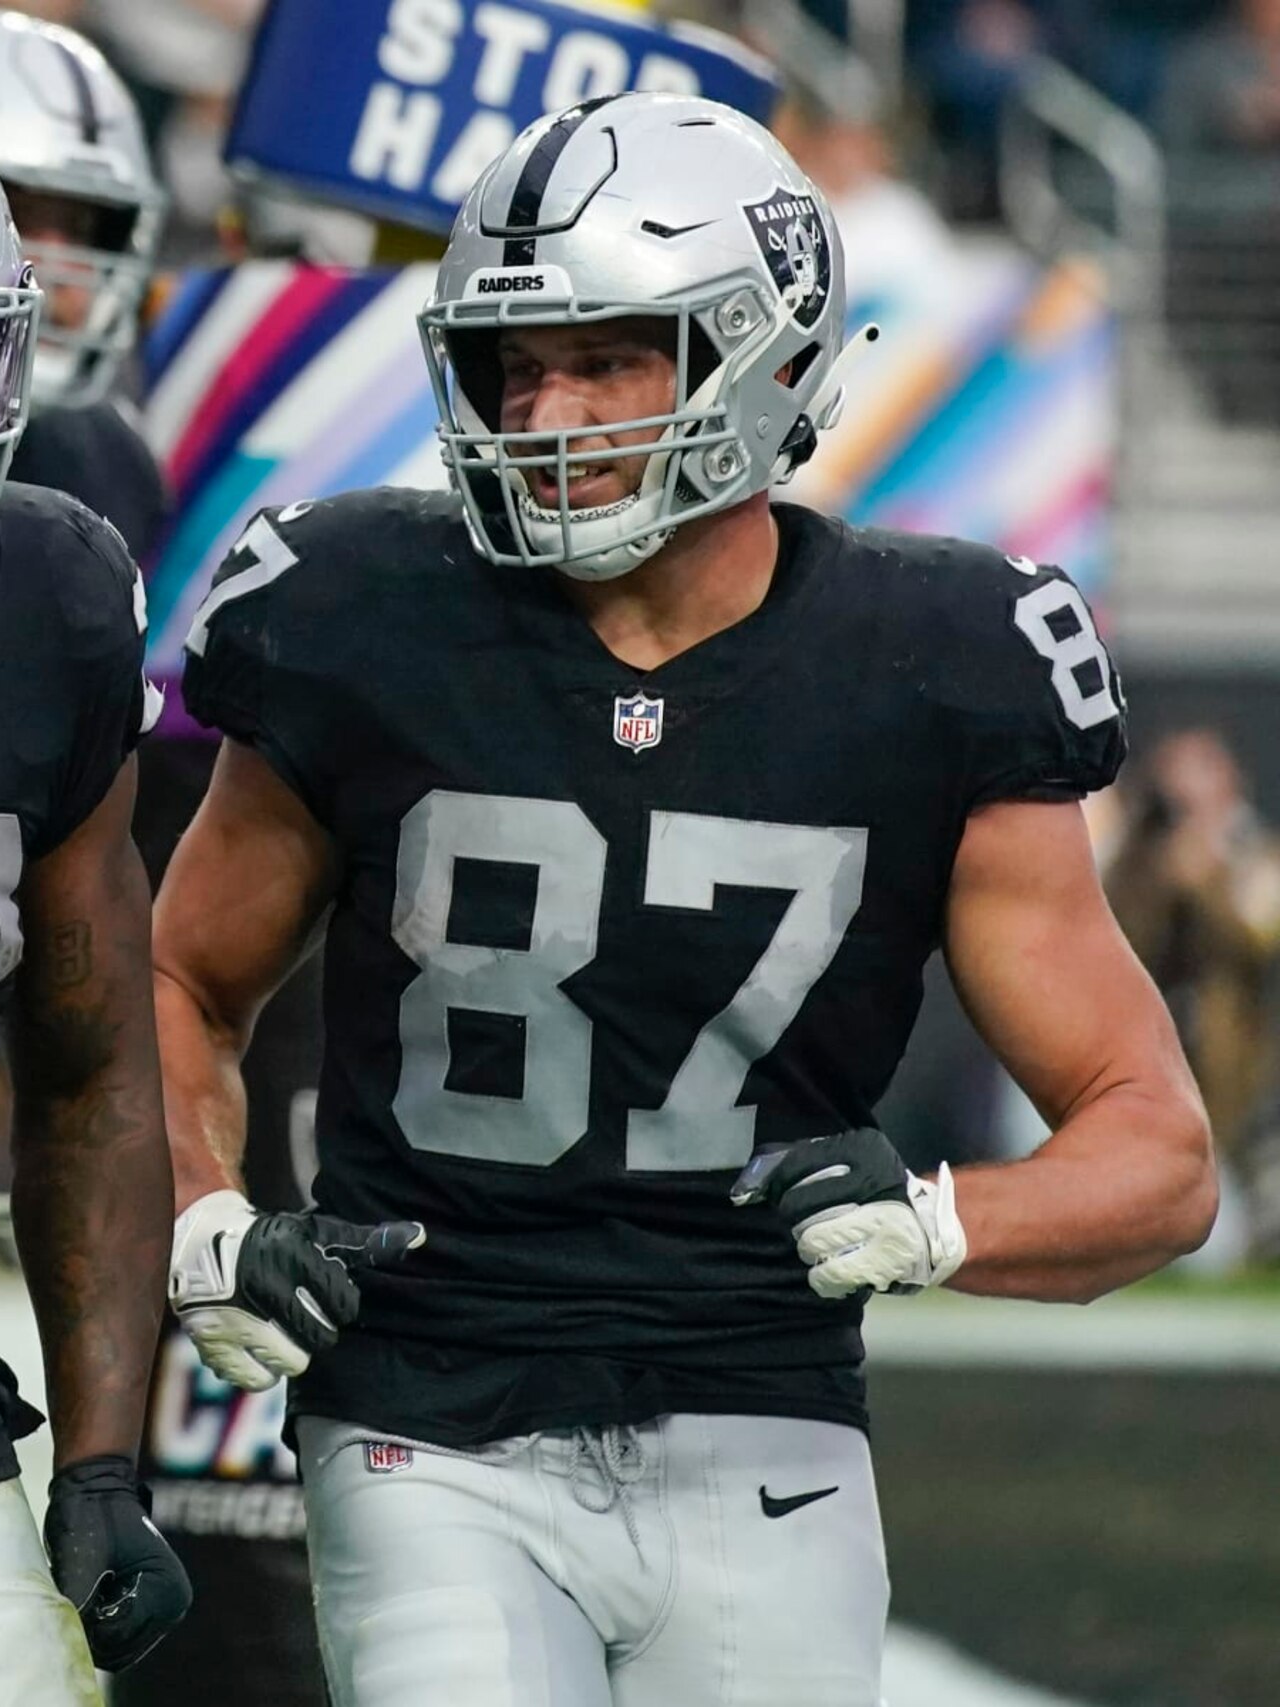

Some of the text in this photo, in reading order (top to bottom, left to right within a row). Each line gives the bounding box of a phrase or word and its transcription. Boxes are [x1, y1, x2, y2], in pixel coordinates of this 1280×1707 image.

[754, 198, 813, 223] RAIDERS
[478, 275, 544, 293] RAIDERS
[1014, 578, 1126, 730] 8
[621, 719, 654, 742] NFL
[392, 790, 868, 1172] 87
[372, 1446, 406, 1466] NFL
